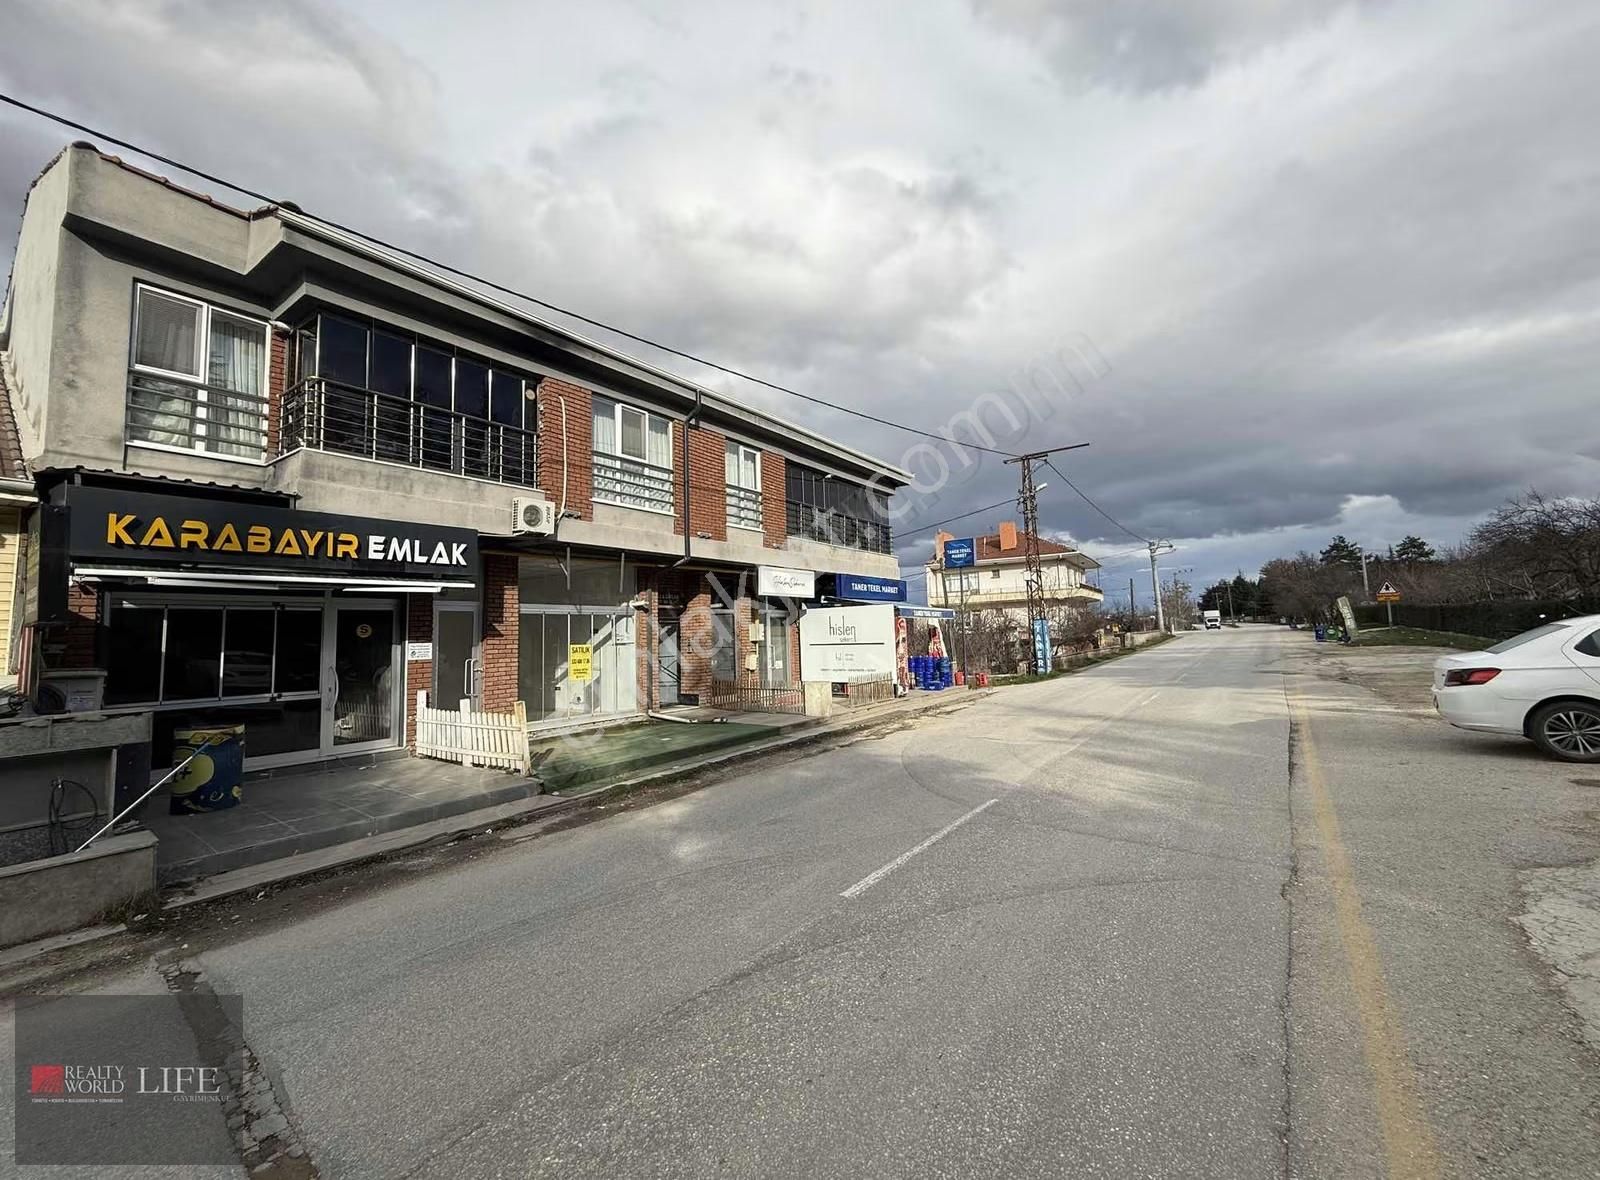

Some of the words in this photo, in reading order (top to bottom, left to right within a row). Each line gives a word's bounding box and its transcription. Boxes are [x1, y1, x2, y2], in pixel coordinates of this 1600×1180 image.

[106, 512, 359, 559] KARABAYIR
[367, 535, 468, 566] EMLAK
[851, 583, 867, 592] TANER
[868, 584, 881, 593] TEKEL
[882, 585, 899, 594] MARKET
[828, 615, 857, 642] hislen
[1035, 625, 1044, 667] TANER
